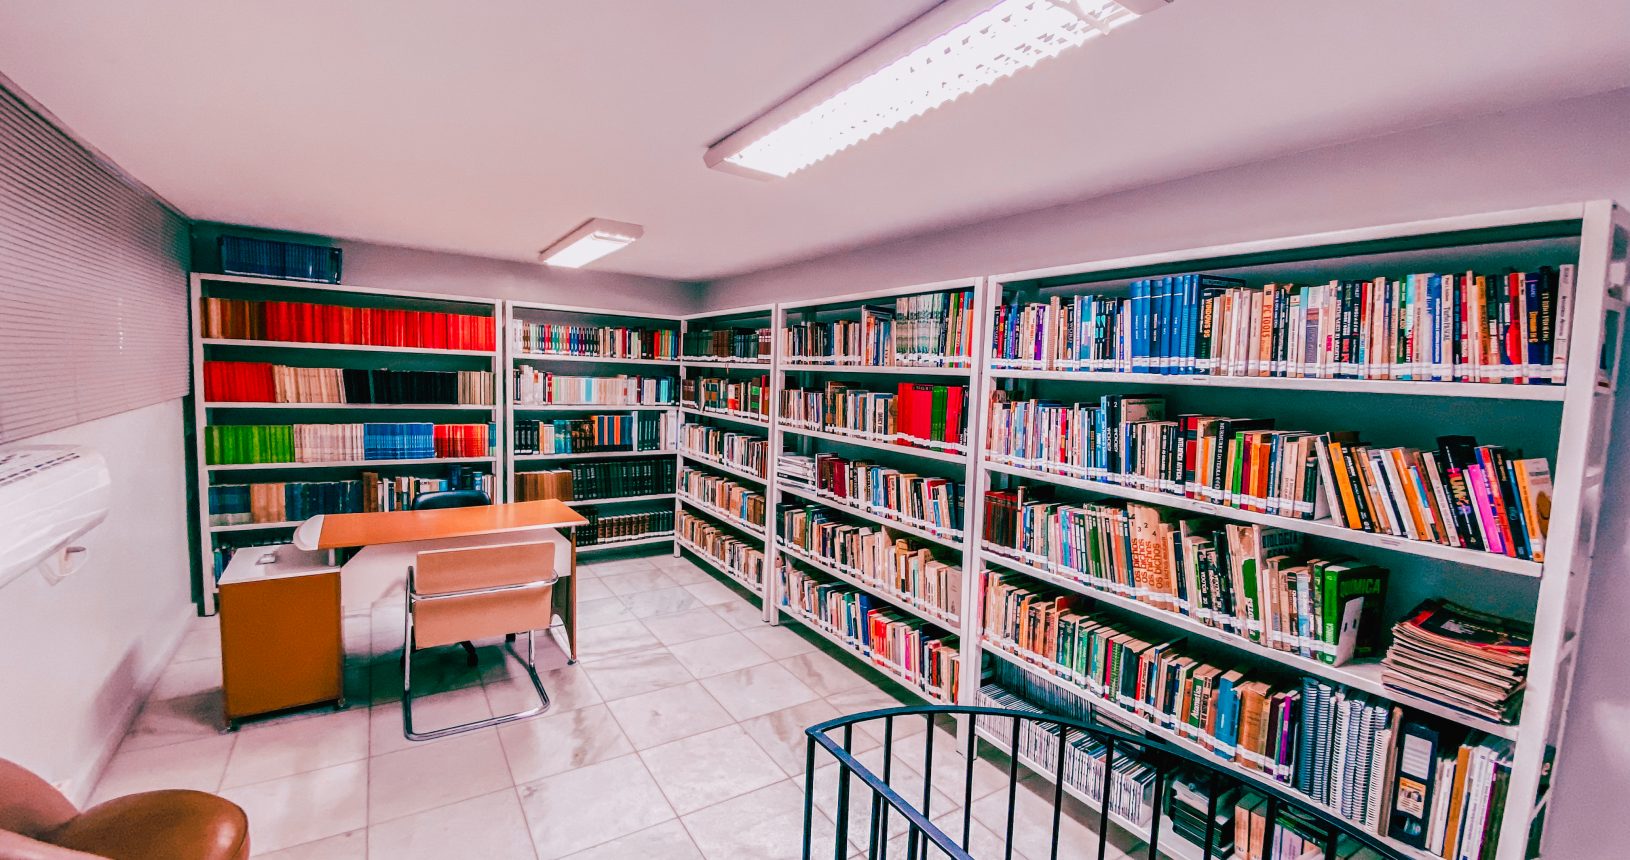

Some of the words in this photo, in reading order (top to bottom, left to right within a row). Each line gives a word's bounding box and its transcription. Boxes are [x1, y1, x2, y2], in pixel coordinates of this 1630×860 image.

[1203, 298, 1213, 329] WINDOWS
[1263, 304, 1273, 314] PC
[1262, 316, 1272, 338] TOOLS
[1151, 543, 1161, 574] bichos
[1141, 571, 1148, 583] os
[1148, 574, 1155, 586] os
[1155, 577, 1163, 589] os
